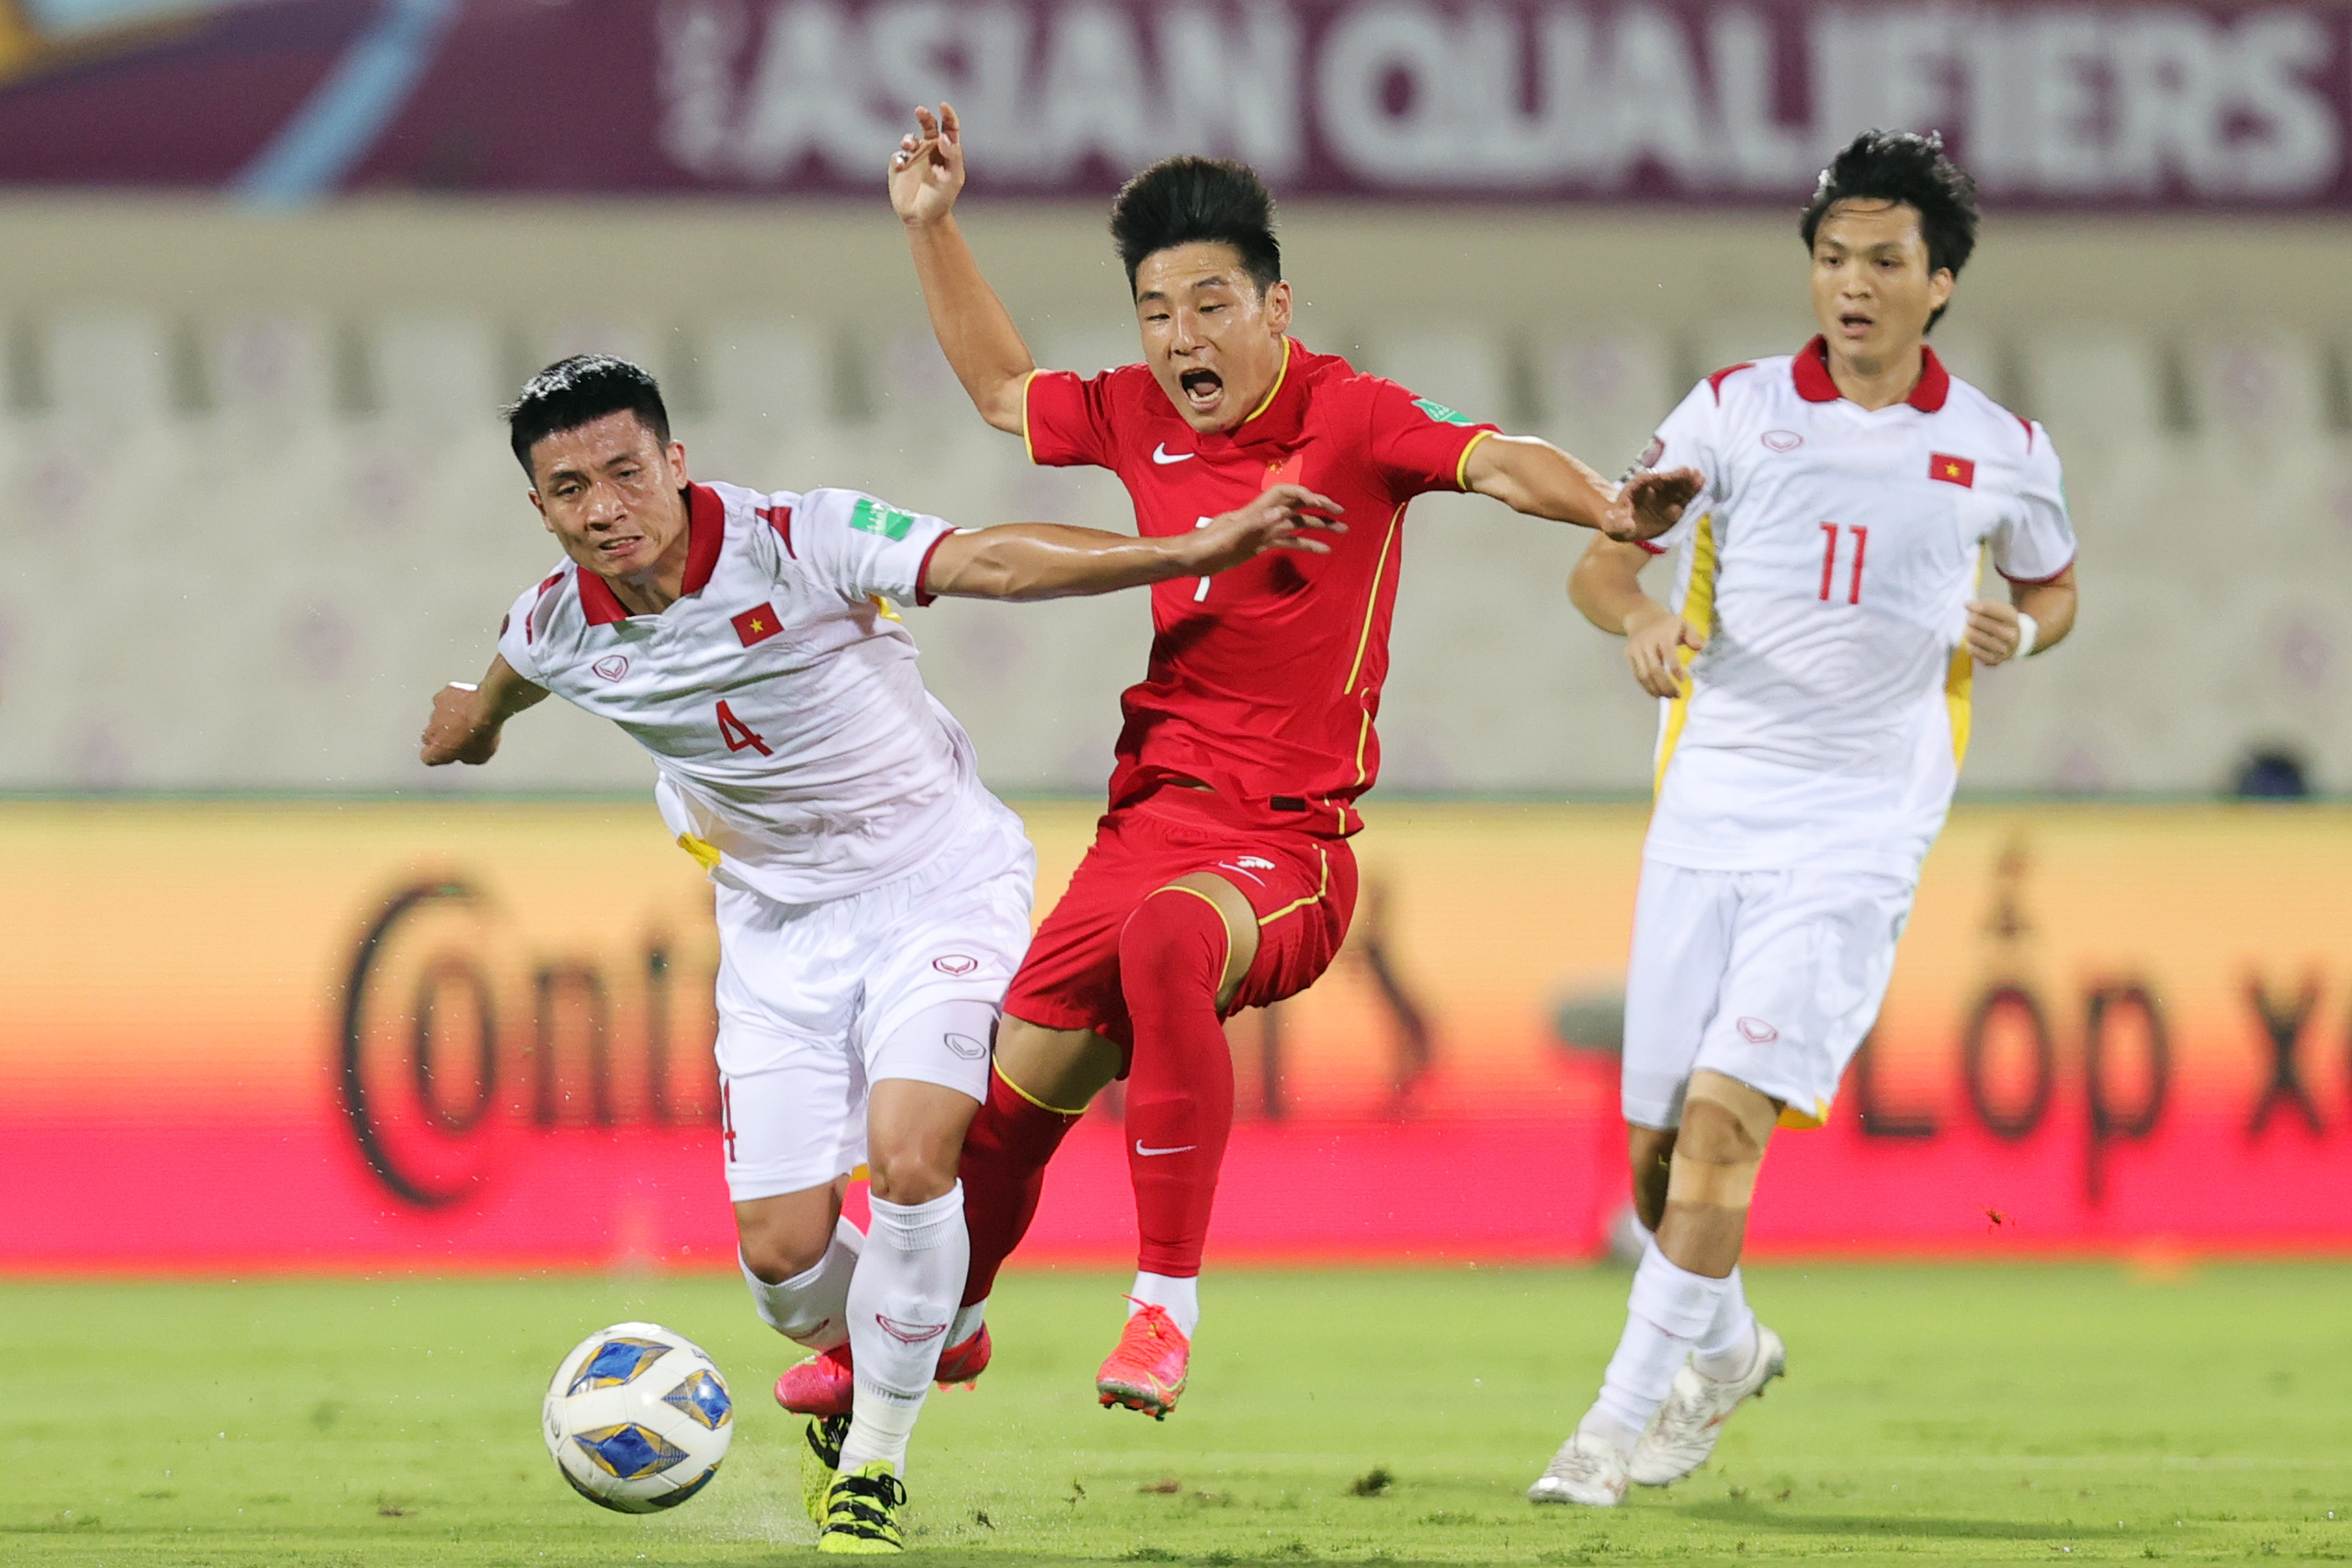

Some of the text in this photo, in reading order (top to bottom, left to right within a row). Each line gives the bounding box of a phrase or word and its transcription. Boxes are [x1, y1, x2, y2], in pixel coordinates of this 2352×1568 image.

[741, 5, 1295, 185] ASIAN
[1313, 5, 2333, 192] QUALIFIERS
[1819, 521, 1867, 606] 11
[716, 699, 774, 757] 4
